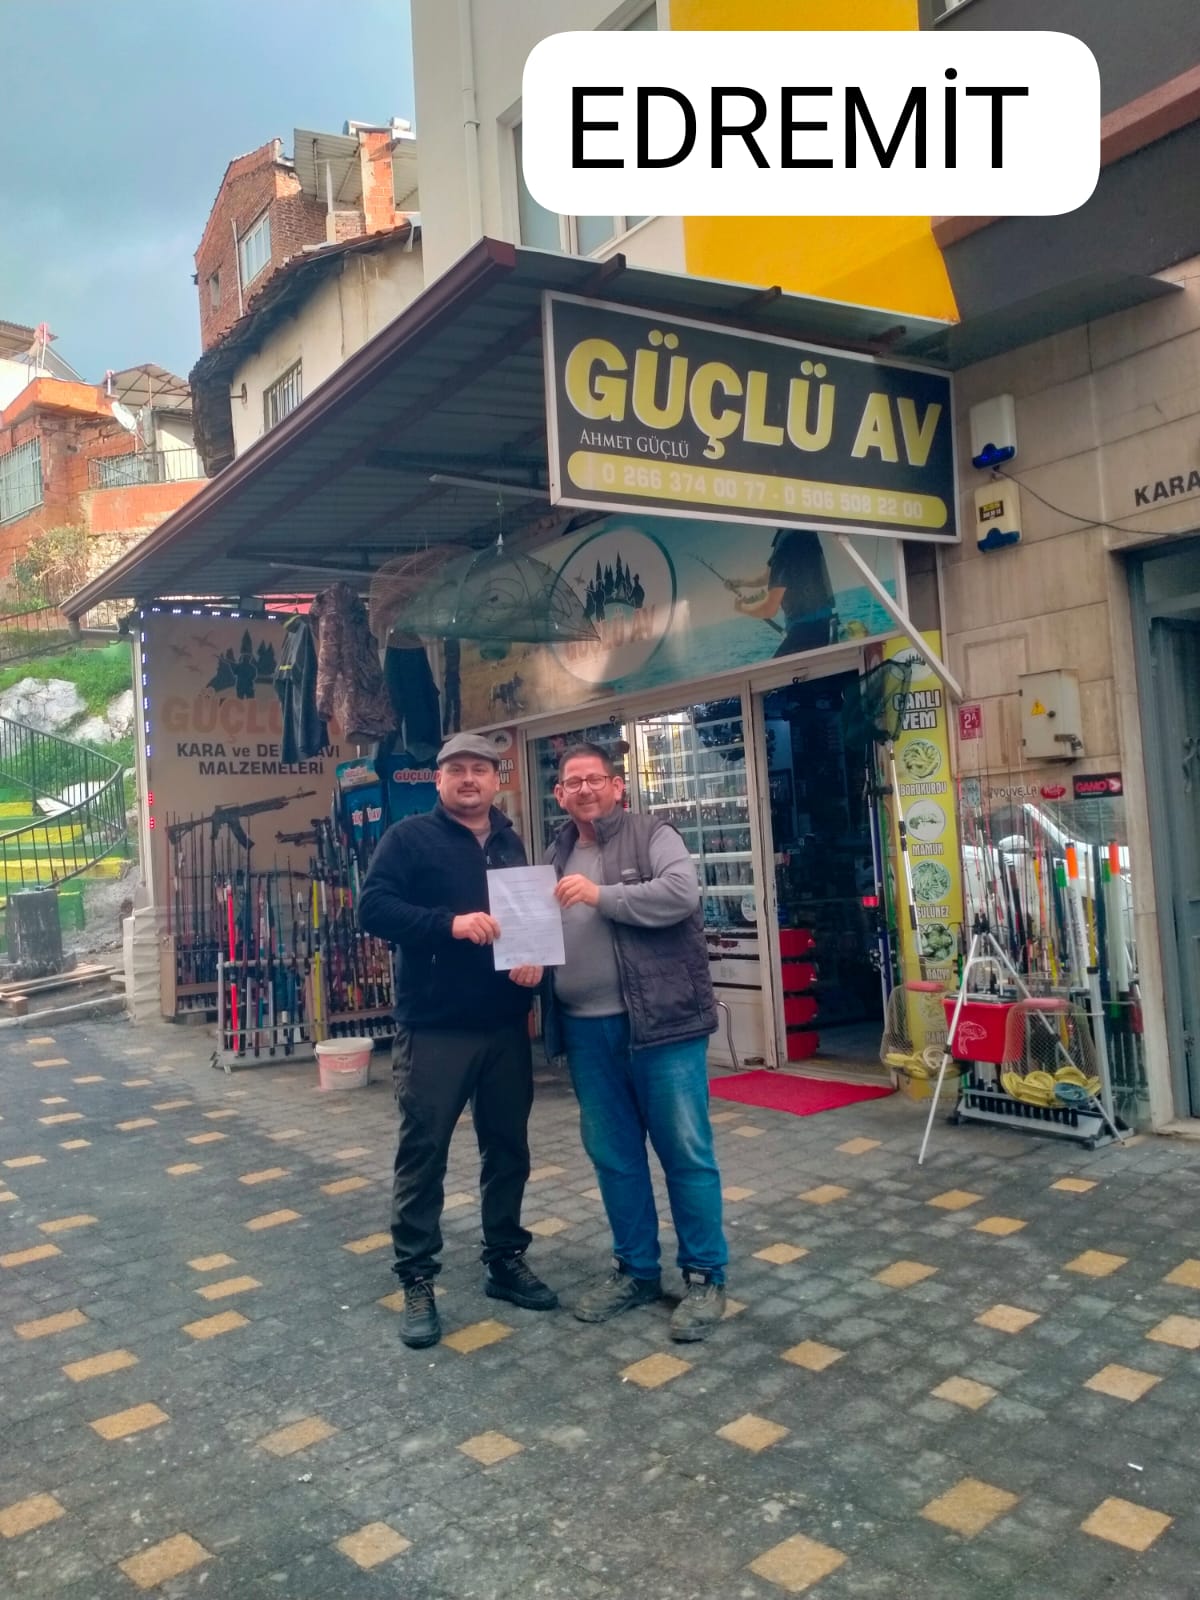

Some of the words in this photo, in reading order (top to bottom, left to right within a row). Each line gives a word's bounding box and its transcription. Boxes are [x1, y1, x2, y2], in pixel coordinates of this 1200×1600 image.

[564, 329, 835, 460] GÜÇLÜ
[850, 392, 942, 467] AV
[580, 428, 632, 450] AHMET
[636, 435, 689, 460] GÜÇLÜ
[602, 461, 616, 484] 0
[623, 465, 662, 489] 266
[670, 471, 706, 495] 374
[713, 477, 737, 499] 00
[744, 481, 766, 503] 77
[877, 496, 897, 516] 22
[893, 689, 942, 712] CANLI
[901, 709, 938, 731] YEM
[176, 743, 226, 758] KARA
[232, 746, 250, 758] ve
[199, 758, 324, 776] MALZEMELERİ
